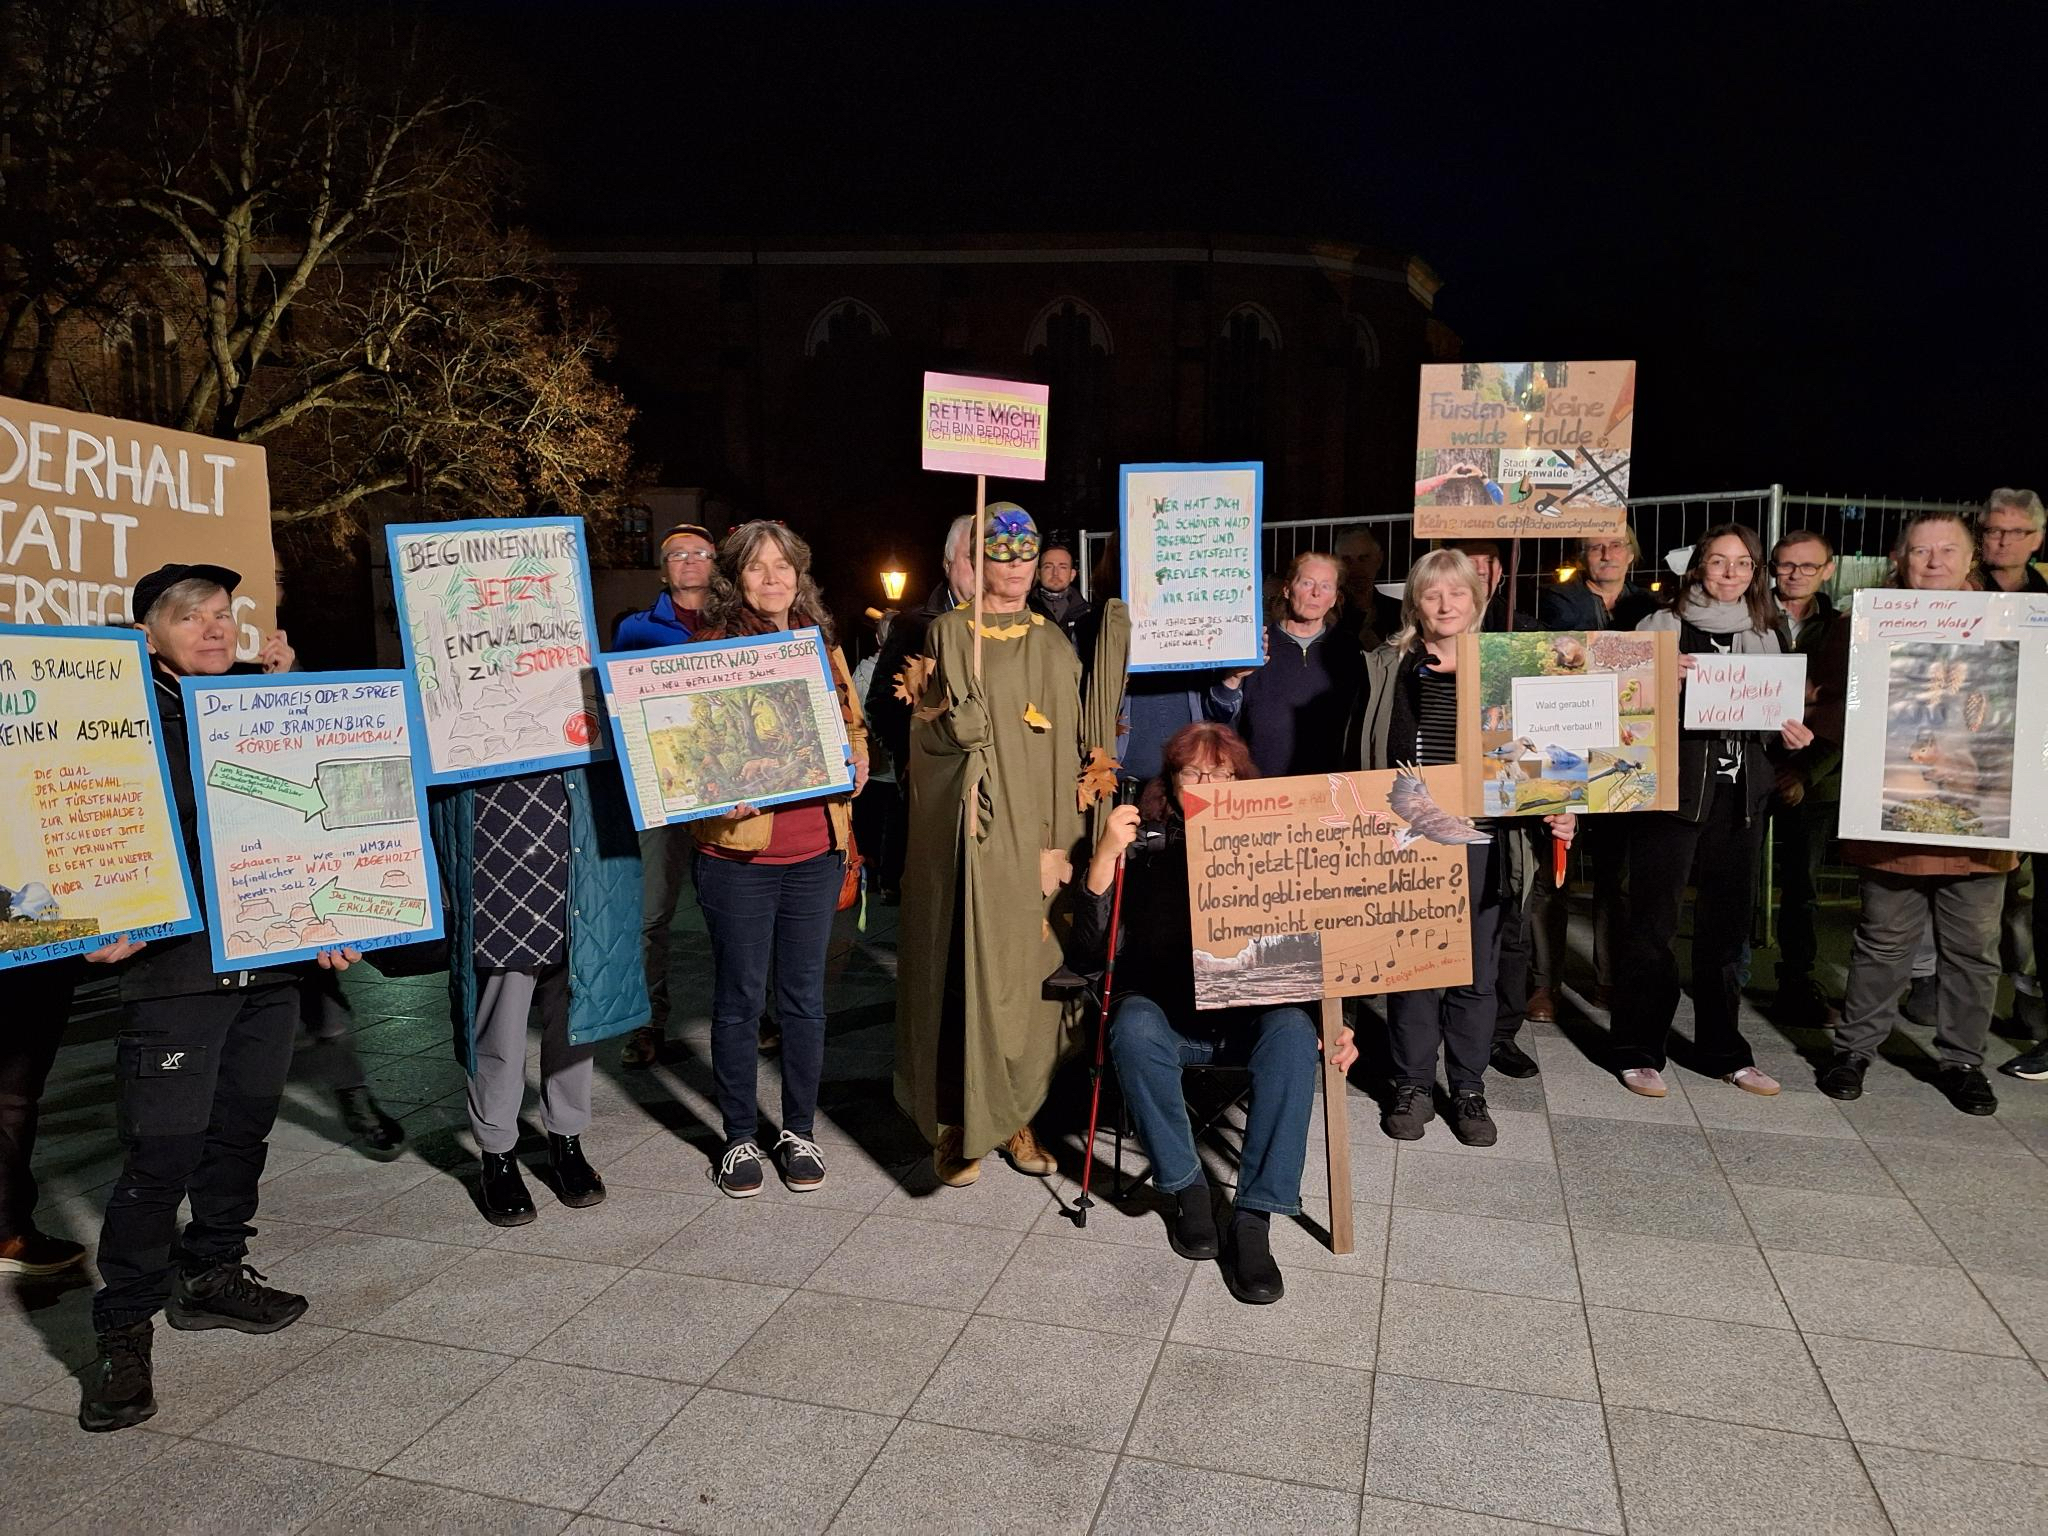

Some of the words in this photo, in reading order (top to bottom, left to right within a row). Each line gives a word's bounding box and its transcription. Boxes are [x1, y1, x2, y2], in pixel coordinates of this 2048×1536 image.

[929, 402, 985, 423] RETTE
[1544, 391, 1605, 418] Keine
[1451, 421, 1508, 446] walde
[1525, 418, 1593, 447] Halde
[1502, 468, 1569, 478] Fürstenwalde
[1503, 458, 1528, 468] Stadt
[1154, 497, 1178, 513] WER
[1184, 497, 1210, 511] HAT
[1418, 514, 1457, 530] Keine
[1459, 519, 1495, 530] neuen
[463, 573, 558, 610] JETZT
[1929, 600, 1957, 611] mir
[1879, 619, 1927, 629] meinen
[444, 620, 581, 659] ENTWALDUNG
[511, 641, 591, 677] STOPPEN
[651, 653, 728, 675] GESCHÜTZTER
[727, 650, 759, 668] WALD
[777, 640, 818, 660] BESSER
[31, 658, 122, 681] BRAUCHEN
[1696, 663, 1746, 685] Wald
[640, 684, 655, 694] ALS
[662, 680, 679, 689] NEU
[1730, 680, 1783, 701] bleibt
[203, 695, 233, 716] Der
[239, 690, 311, 711] LANDKREIS
[315, 688, 349, 704] ODER
[352, 685, 400, 699] SPREE
[288, 704, 309, 716] und
[1535, 700, 1557, 710] Wald
[1558, 700, 1590, 711] geraubt
[1698, 704, 1744, 724] Wald
[76, 718, 152, 744] ASPHALT!
[209, 729, 230, 742] das
[239, 721, 275, 737] LAND
[280, 714, 386, 735] BRANDENBURG
[1529, 723, 1560, 734] Zukunft
[1562, 722, 1592, 731] verbaut
[235, 737, 303, 754] FÖRDERN
[34, 768, 52, 779] DIE
[35, 783, 57, 796] DER
[60, 776, 122, 792] LANGEWAHL
[40, 798, 57, 810] MIT
[1214, 788, 1293, 820] Hymne
[41, 817, 63, 829] ZUR
[119, 824, 145, 836] BITTE
[1201, 825, 1248, 856] Lange
[1252, 830, 1280, 846] war
[1287, 822, 1313, 844] ich
[1316, 825, 1351, 843] euer
[46, 847, 65, 859] MIT
[73, 840, 128, 856] VERNUNFT
[228, 854, 280, 872] schauen
[286, 854, 301, 862] zu
[342, 848, 355, 858] im
[359, 839, 402, 855] UMBAU
[49, 864, 61, 874] ES
[65, 859, 93, 871] GEHT
[100, 856, 115, 867] UM
[231, 867, 295, 887] befindlicher
[305, 859, 342, 874] WALD
[353, 848, 421, 871] ABGEHOLZT
[1205, 855, 1244, 878] doch
[1247, 851, 1294, 880] jetzt
[1345, 844, 1371, 867] ich
[52, 881, 84, 896] KINDER
[237, 886, 277, 901] werden
[1198, 882, 1221, 912] Wo
[1222, 880, 1259, 907] sind
[1262, 877, 1342, 913] geblieben
[1343, 879, 1387, 899] meine
[1388, 868, 1446, 896] Wälder
[329, 890, 346, 900] Das
[399, 900, 422, 910] EINER
[1208, 917, 1232, 943] Ich
[1233, 922, 1264, 944] mag
[1264, 909, 1308, 935] nicht
[1314, 915, 1364, 931] euren
[1365, 895, 1466, 927] Stahlbeton!
[13, 950, 37, 963] WAS
[42, 940, 86, 958] TESLA
